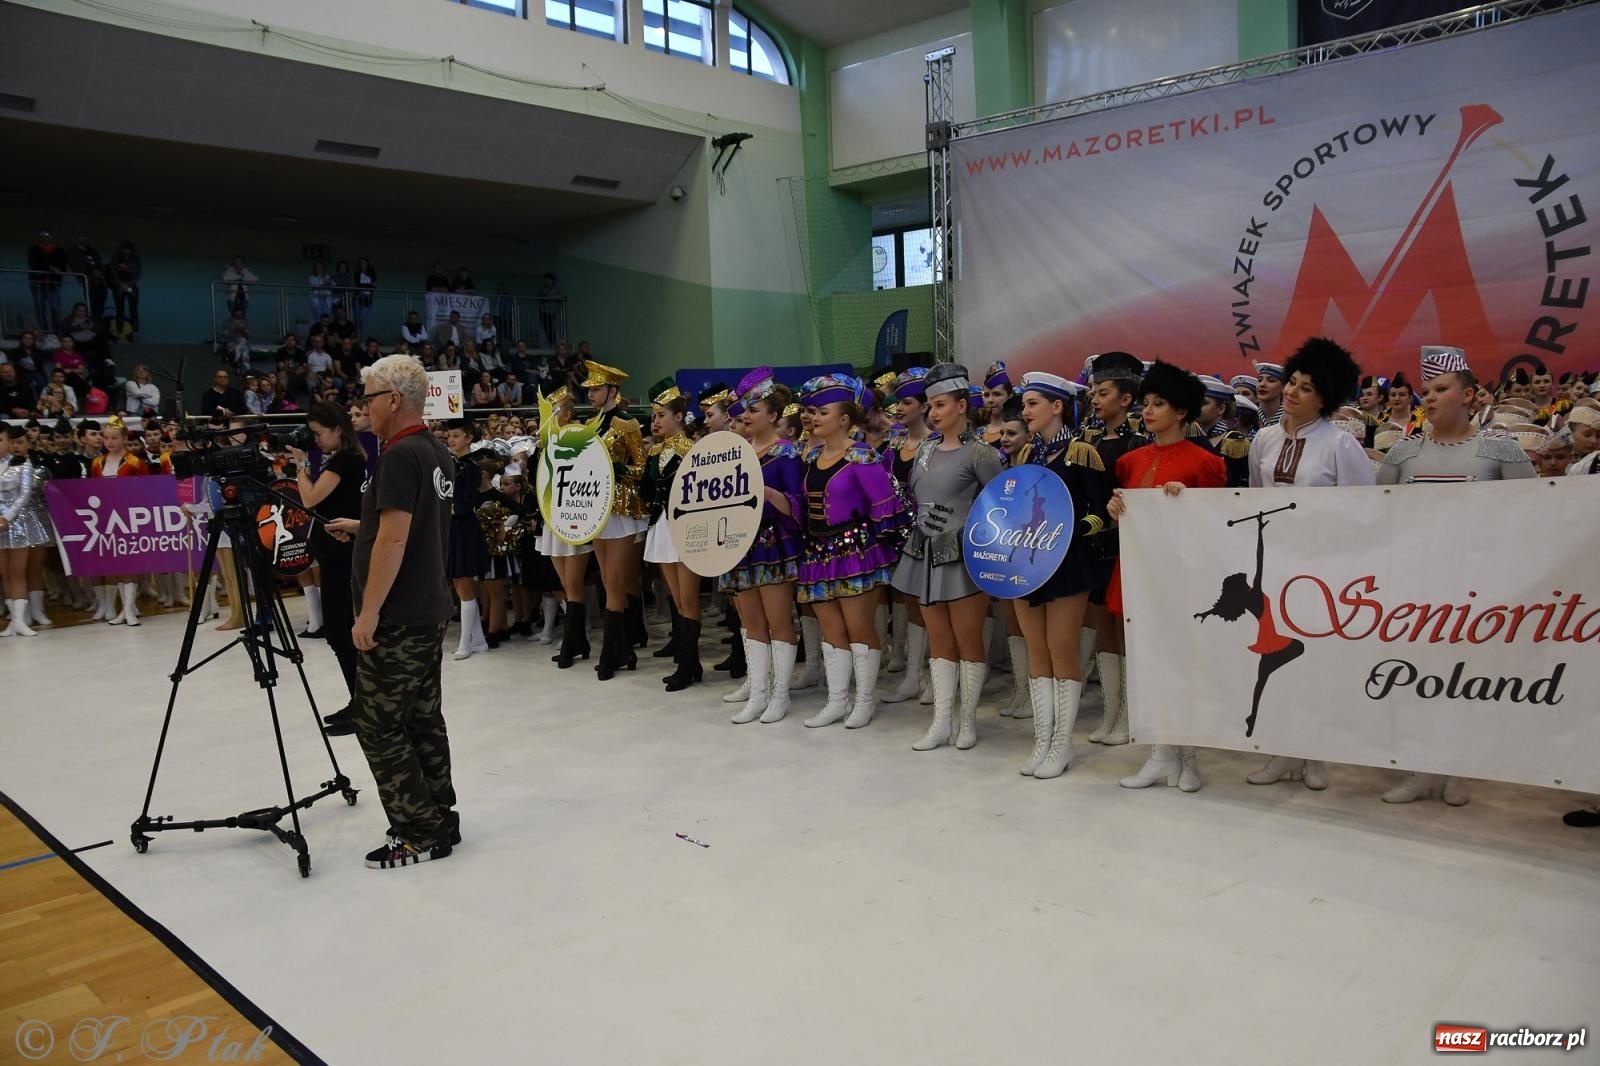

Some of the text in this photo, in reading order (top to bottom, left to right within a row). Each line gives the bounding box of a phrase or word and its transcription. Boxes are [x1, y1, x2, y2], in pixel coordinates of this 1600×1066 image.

[966, 105, 1276, 177] WWW.MAZORETKI.PL
[1231, 113, 1437, 358] ZWIĄZEK SPORTOWY
[691, 445, 742, 468] Mażoretki
[556, 464, 601, 508] Fenix
[565, 499, 593, 508] RADLIN
[680, 462, 750, 505] Fresh
[560, 512, 588, 521] POLAND
[969, 507, 1064, 551] Scarlet
[99, 529, 194, 558] Mażoretki
[973, 550, 1008, 563] MAŻORETKI
[1365, 658, 1567, 705] Poland
